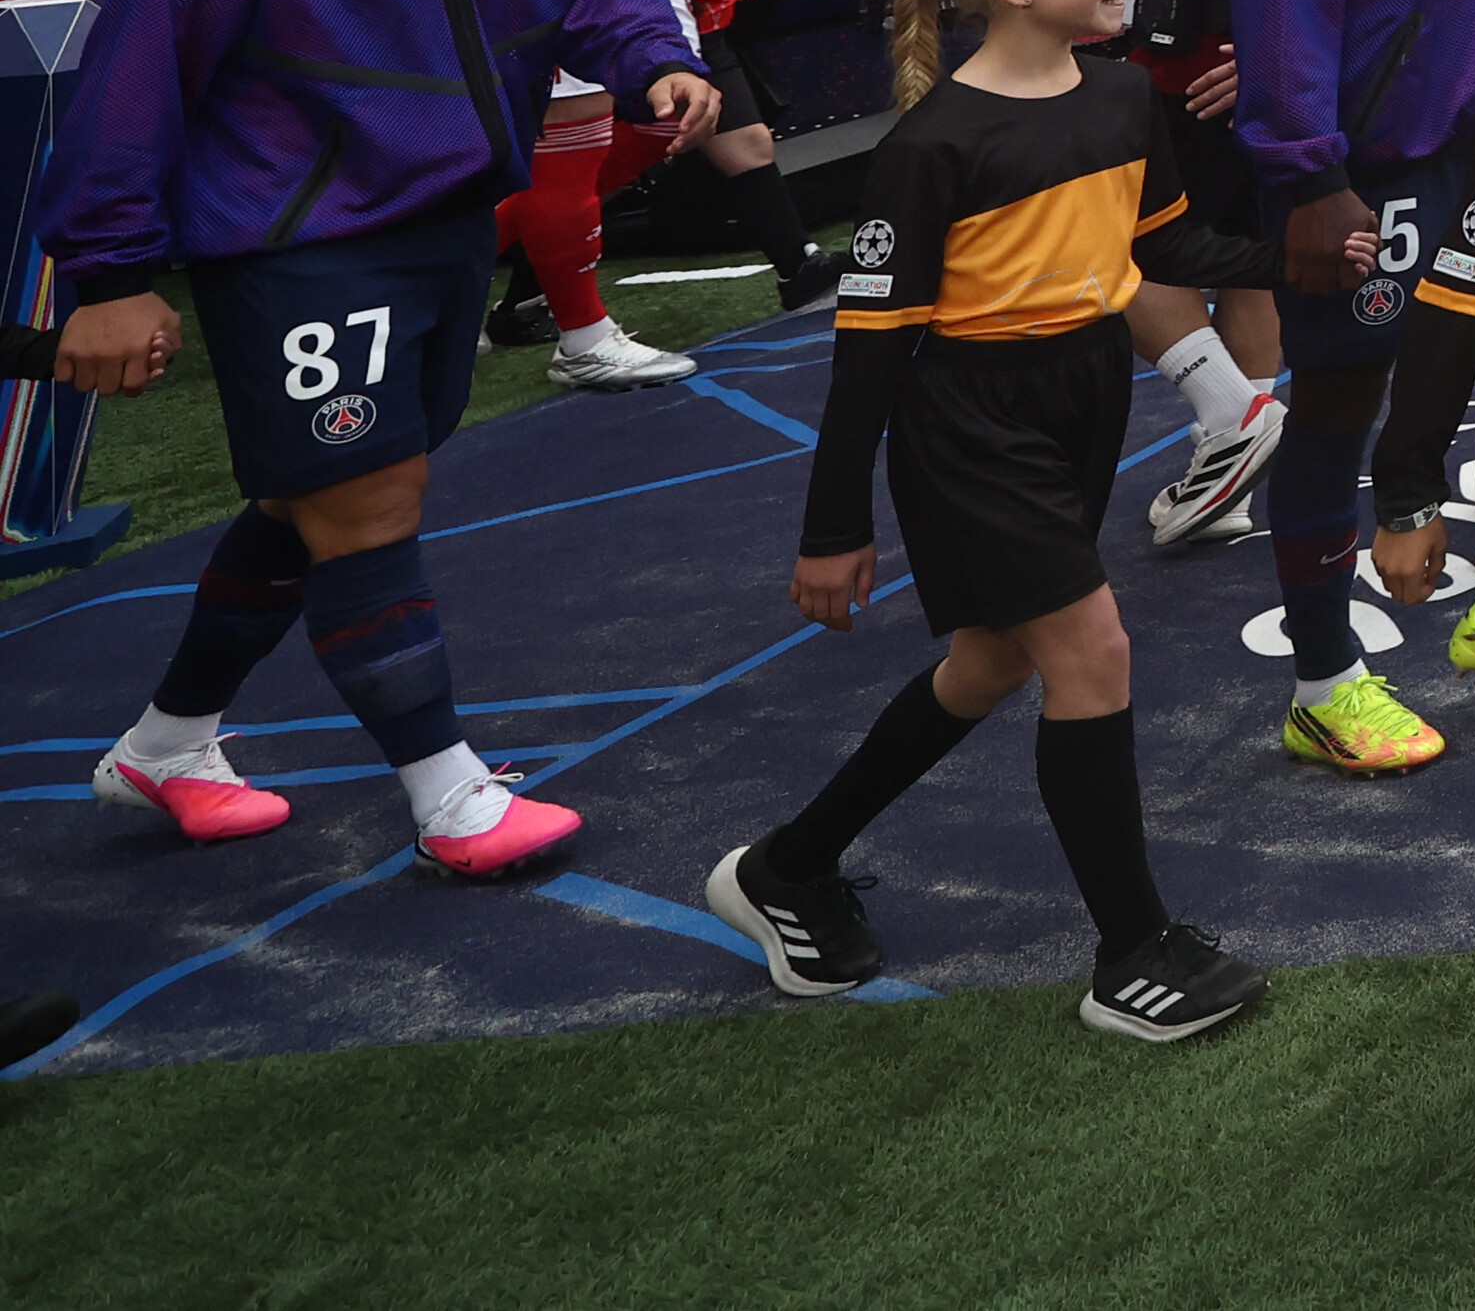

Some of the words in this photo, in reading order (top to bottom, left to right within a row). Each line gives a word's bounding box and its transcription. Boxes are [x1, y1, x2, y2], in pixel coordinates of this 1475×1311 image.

[1378, 197, 1420, 273] 5
[840, 280, 889, 290] FOUNDATION
[1360, 279, 1397, 296] PARIS
[283, 306, 391, 401] 87
[322, 396, 364, 416] PARIS
